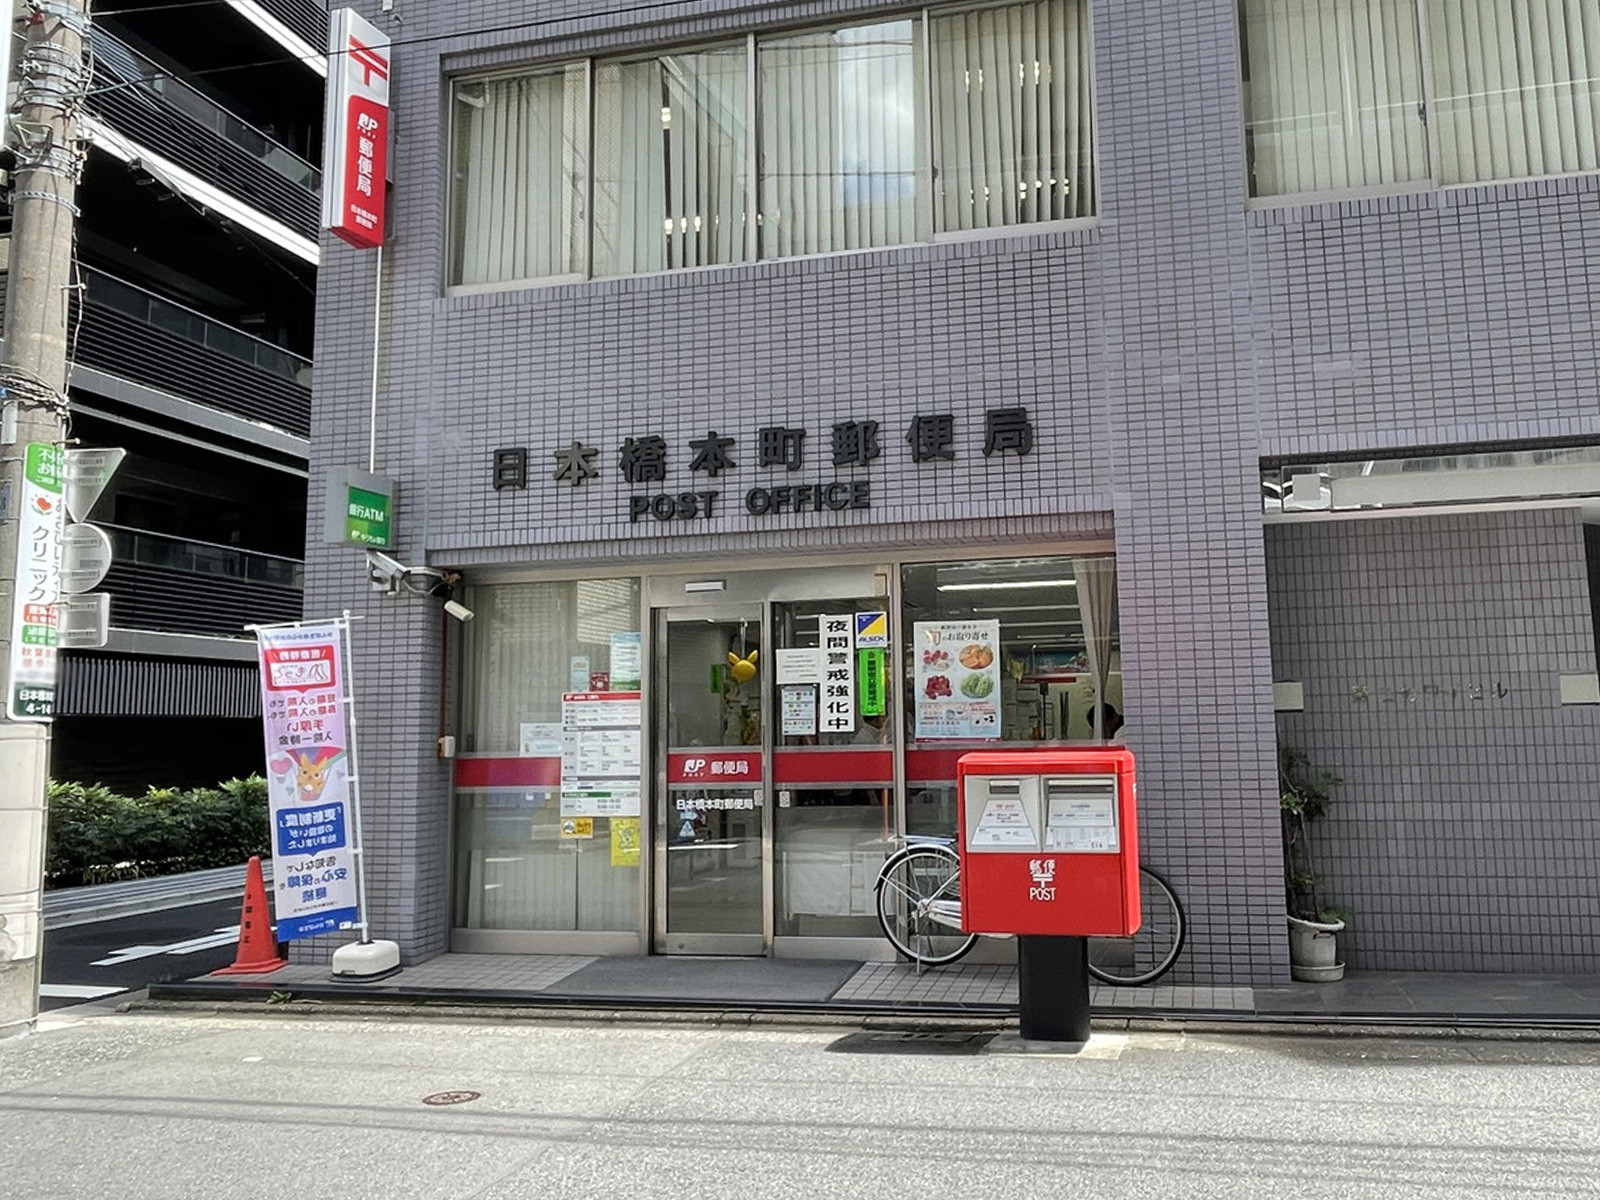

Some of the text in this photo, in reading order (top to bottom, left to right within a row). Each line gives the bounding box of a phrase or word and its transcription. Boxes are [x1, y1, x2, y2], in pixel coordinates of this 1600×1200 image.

[357, 137, 374, 197] 郵便局
[492, 407, 1032, 491] 日本橋本町郵便局
[349, 503, 384, 522] 銀行ATM
[629, 481, 870, 523] POST OFFICE
[29, 525, 49, 601] クリニック
[826, 619, 849, 730] 夜間警戒強化中
[710, 760, 748, 774] 郵便局
[676, 798, 754, 810] 日本橋本町郵便局
[1029, 859, 1056, 875] 郵便
[1030, 887, 1056, 901] POST
